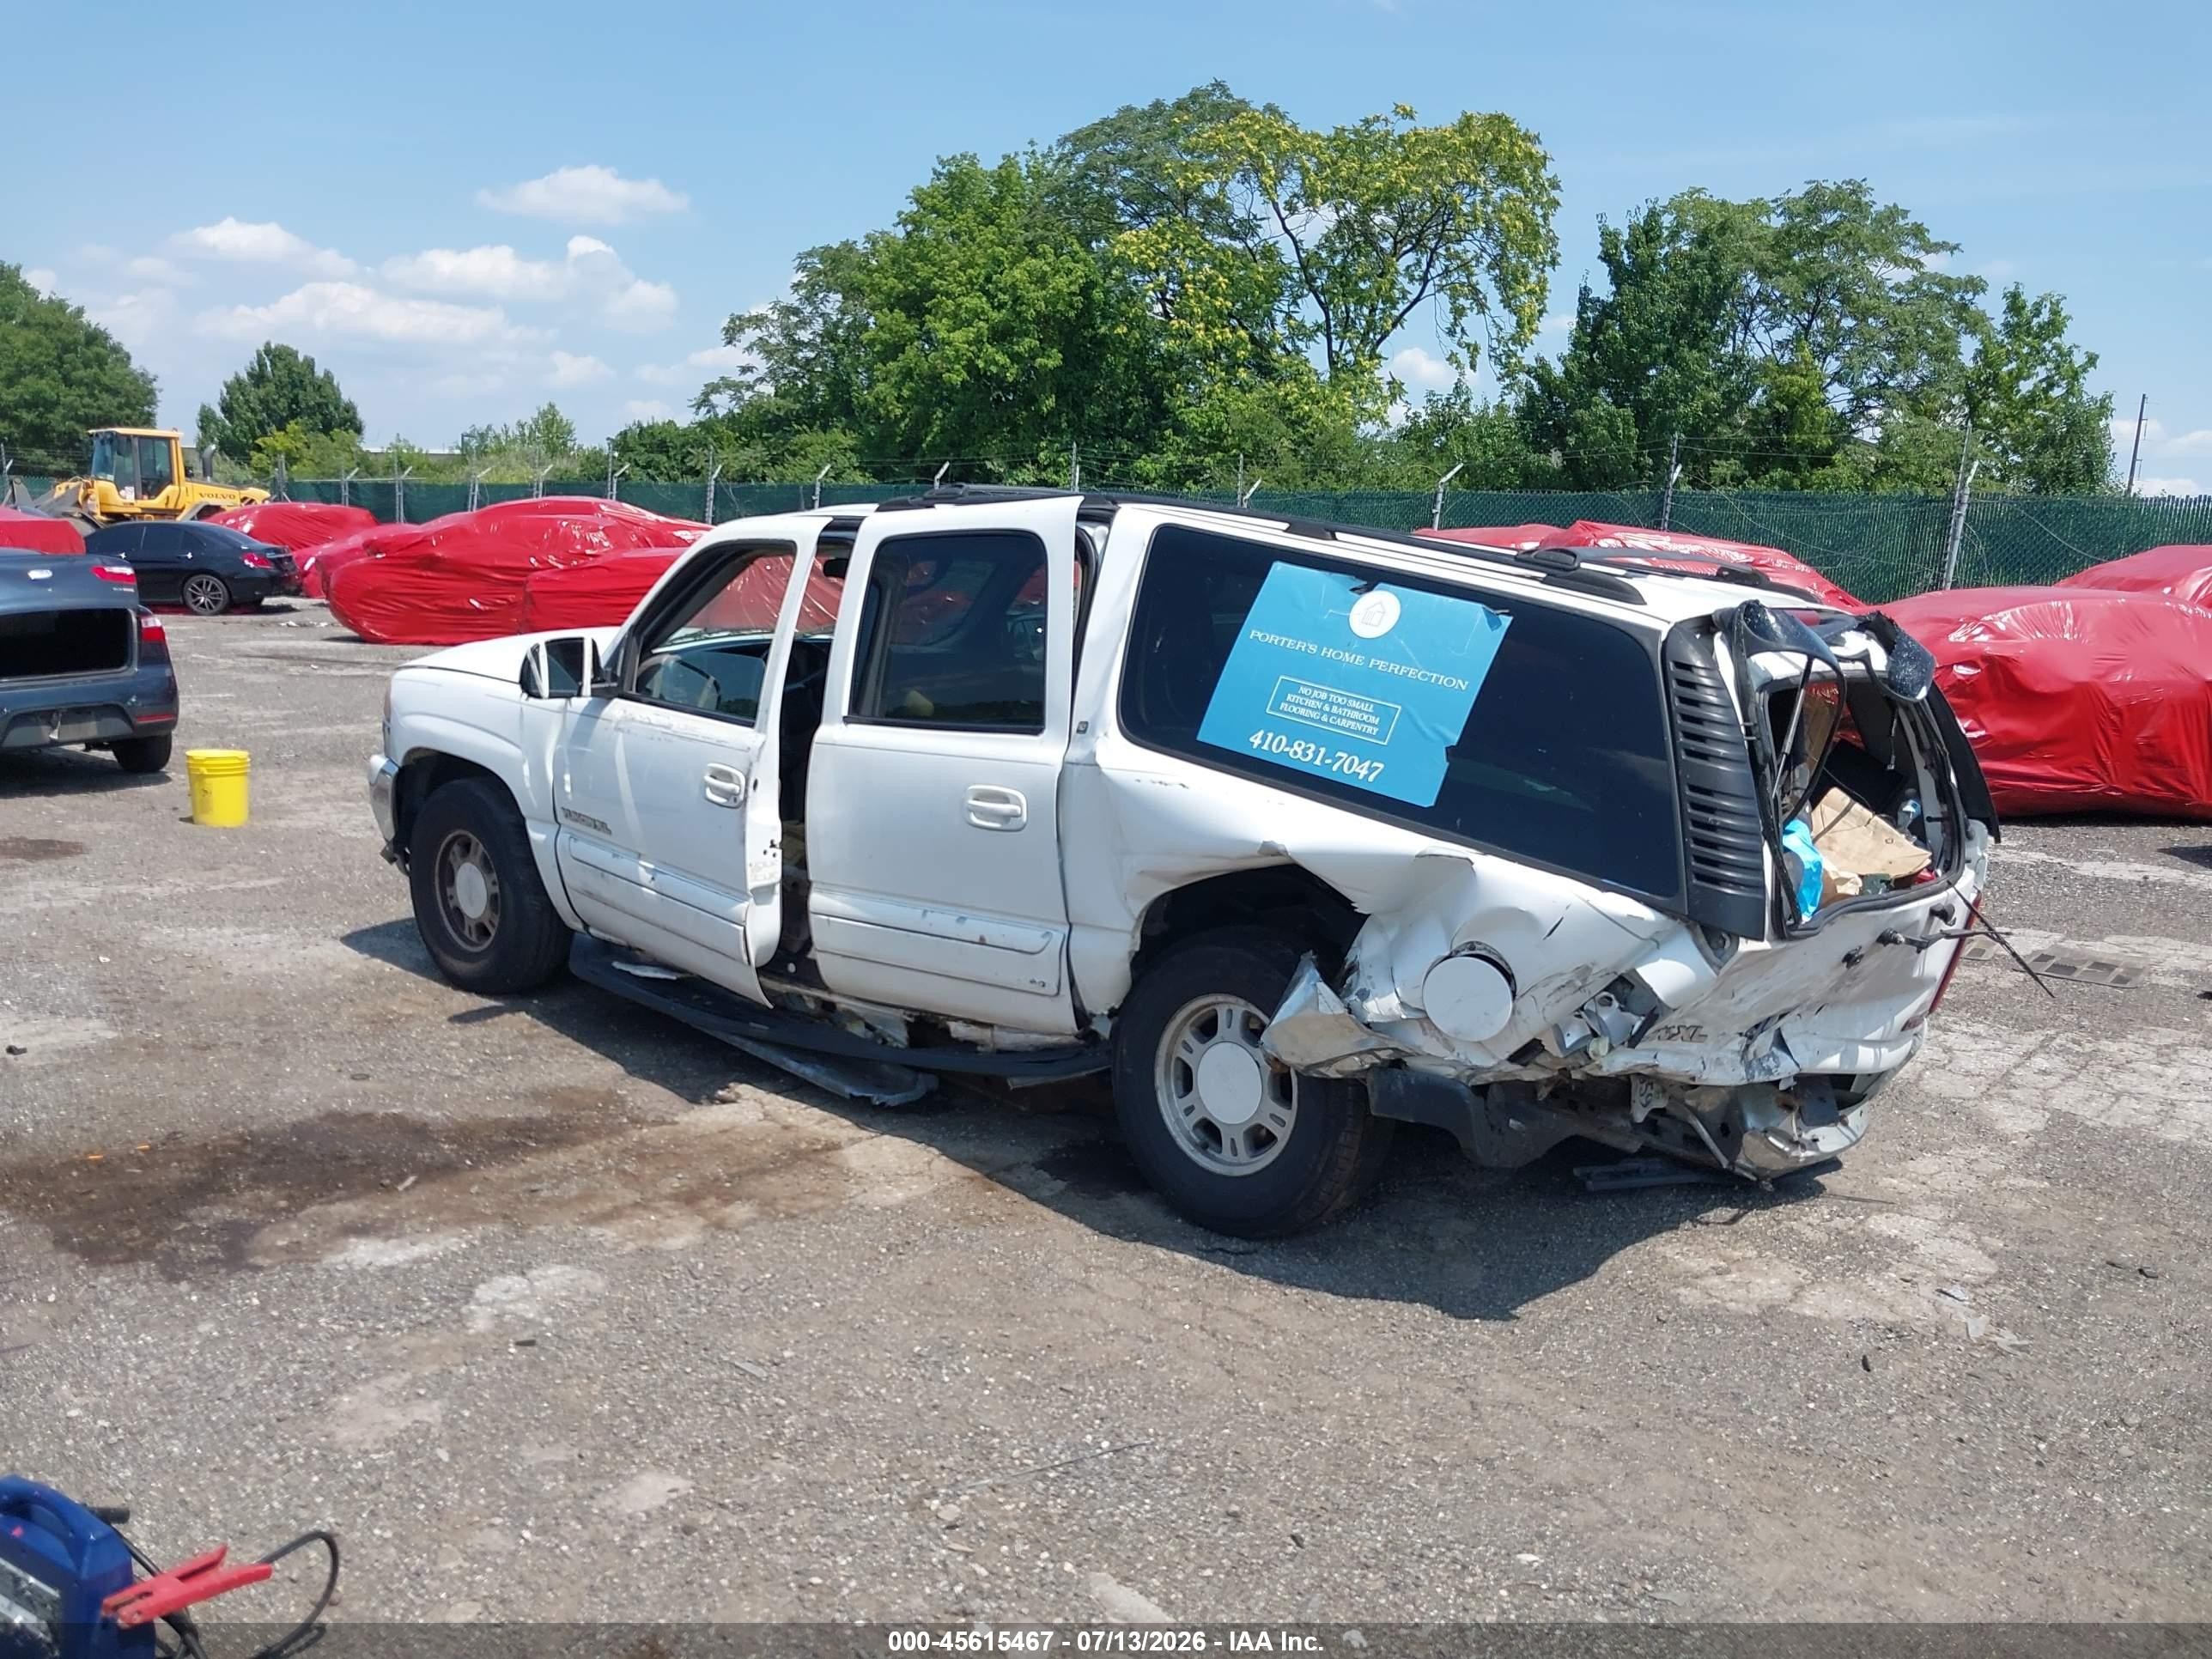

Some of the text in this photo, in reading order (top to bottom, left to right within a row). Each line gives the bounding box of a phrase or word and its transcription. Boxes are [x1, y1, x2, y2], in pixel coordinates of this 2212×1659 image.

[1249, 629, 1470, 691] PORTER'S HOME PERFECTION
[1286, 693, 1322, 710] KITCHEN
[1331, 704, 1380, 726] BATHROOM
[1297, 686, 1374, 713] NO JOB TOO SMALL
[1279, 702, 1379, 736] FLOORING & CARPENTRY
[1249, 729, 1385, 783] 410-831-7047
